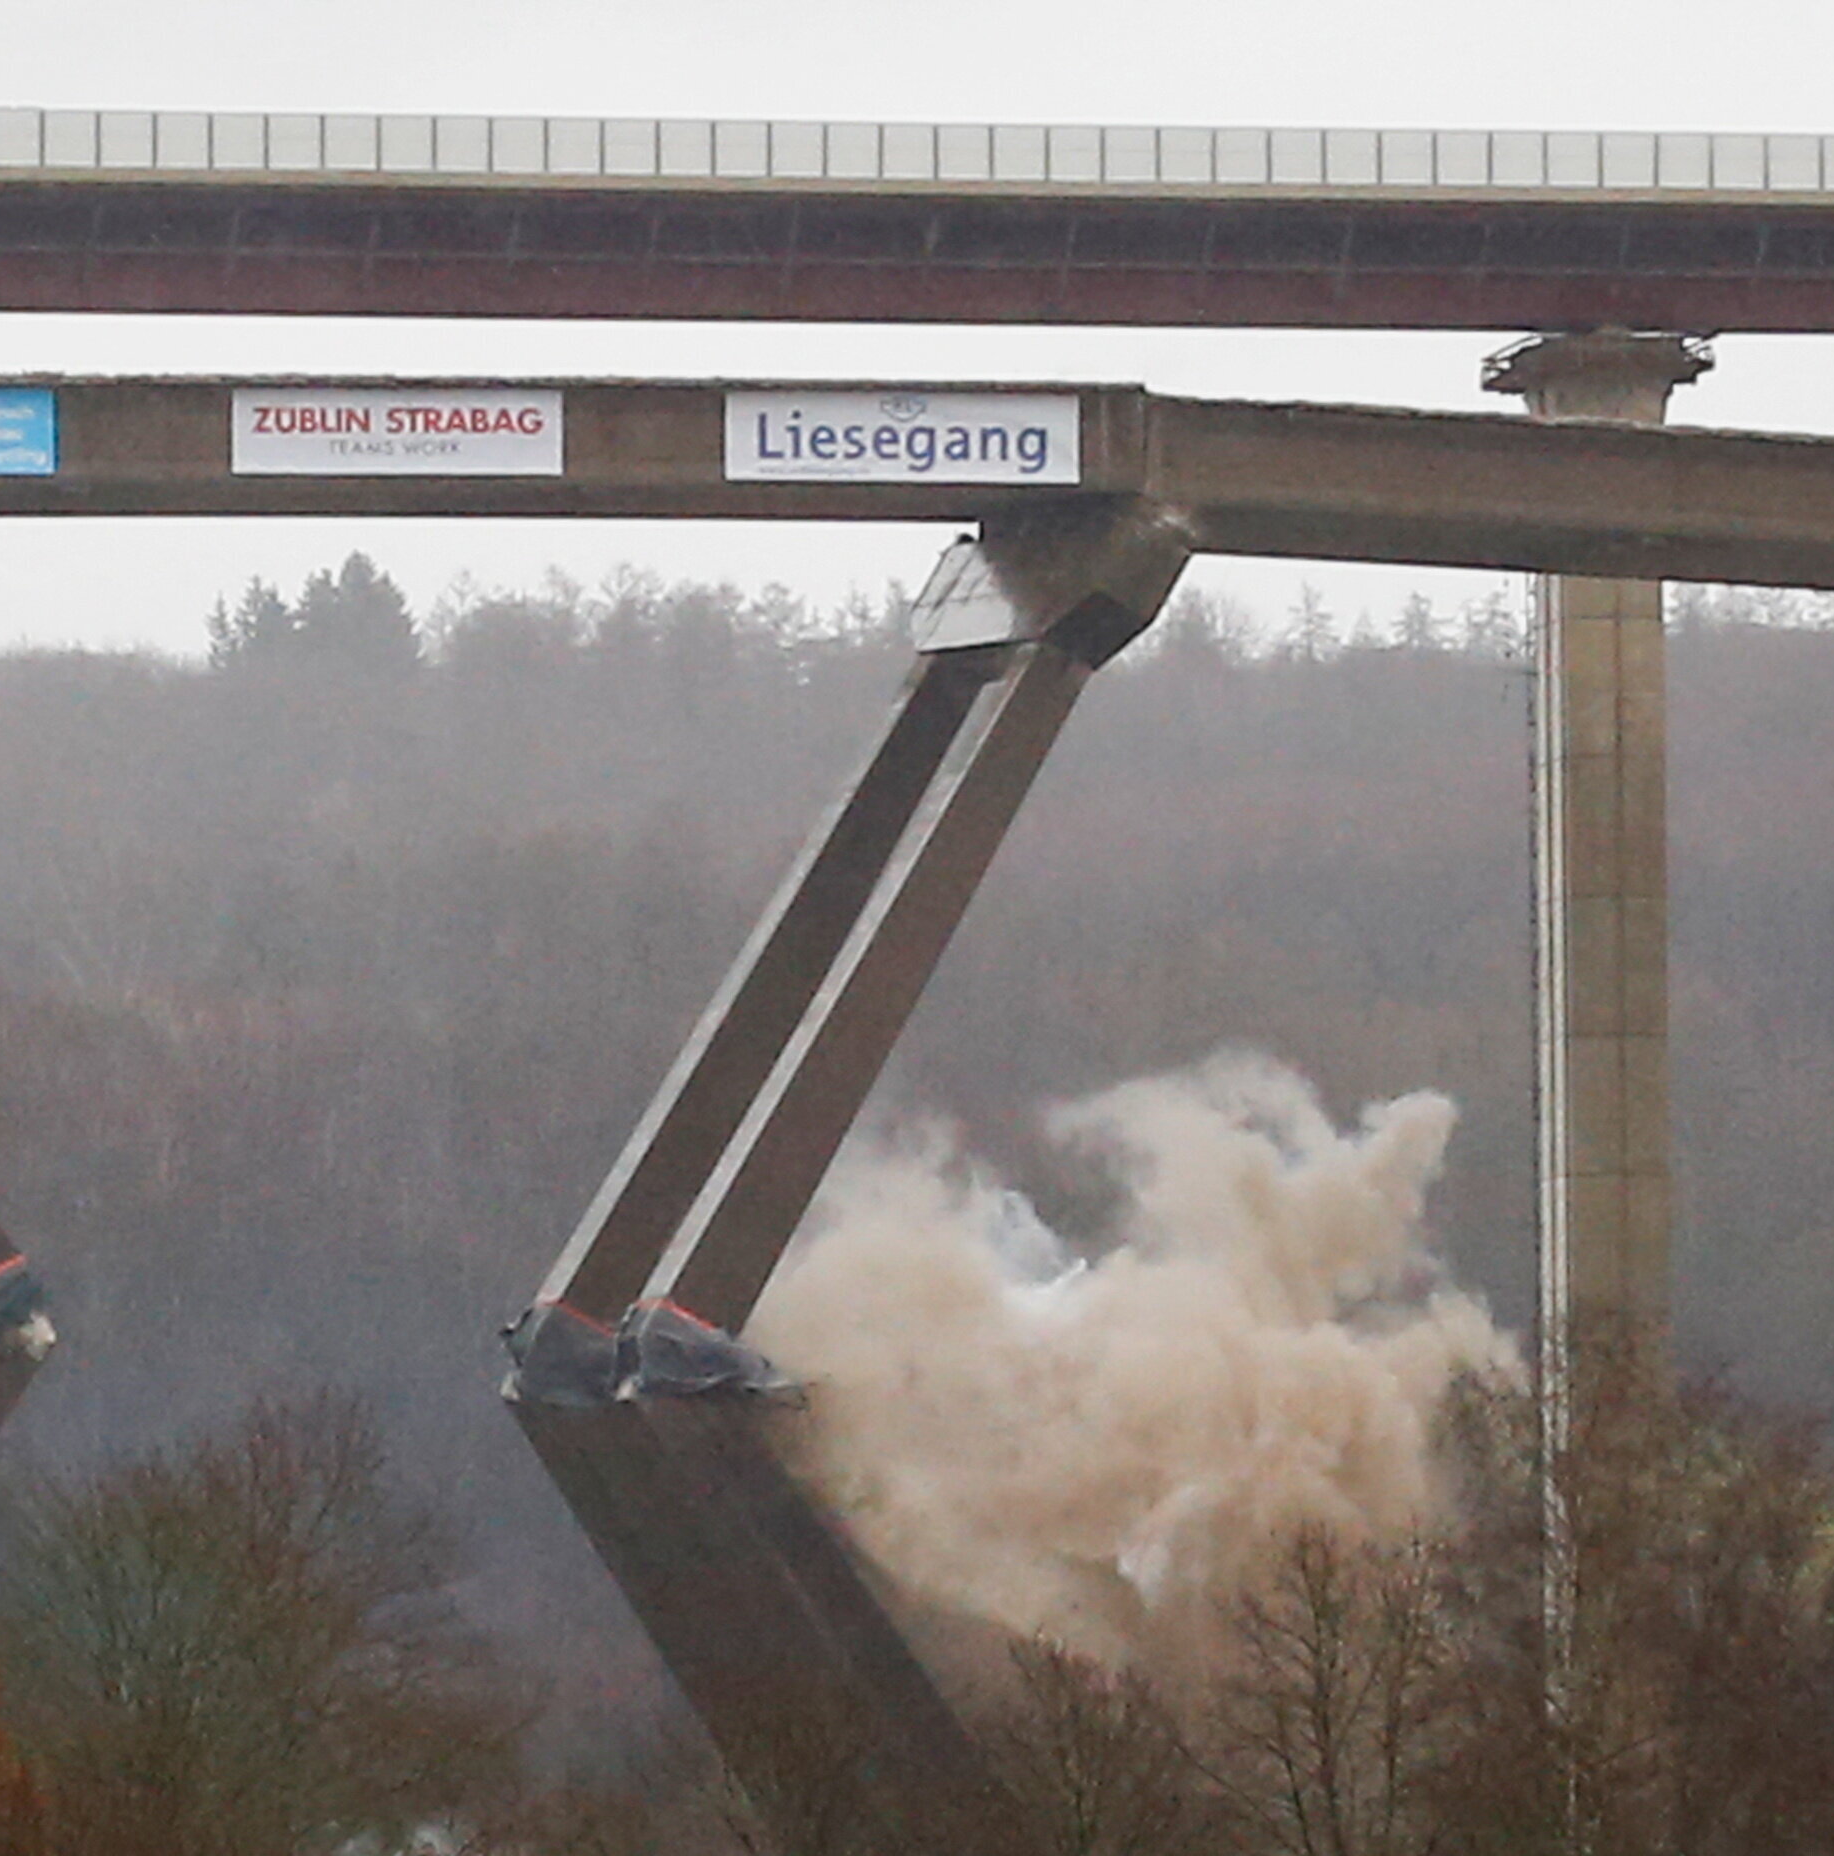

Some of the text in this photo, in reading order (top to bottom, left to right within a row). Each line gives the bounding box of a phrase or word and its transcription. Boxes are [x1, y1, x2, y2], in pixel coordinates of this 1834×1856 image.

[386, 407, 544, 434] STRABAG
[403, 440, 461, 456] WORK
[758, 411, 1048, 474] Liesegang
